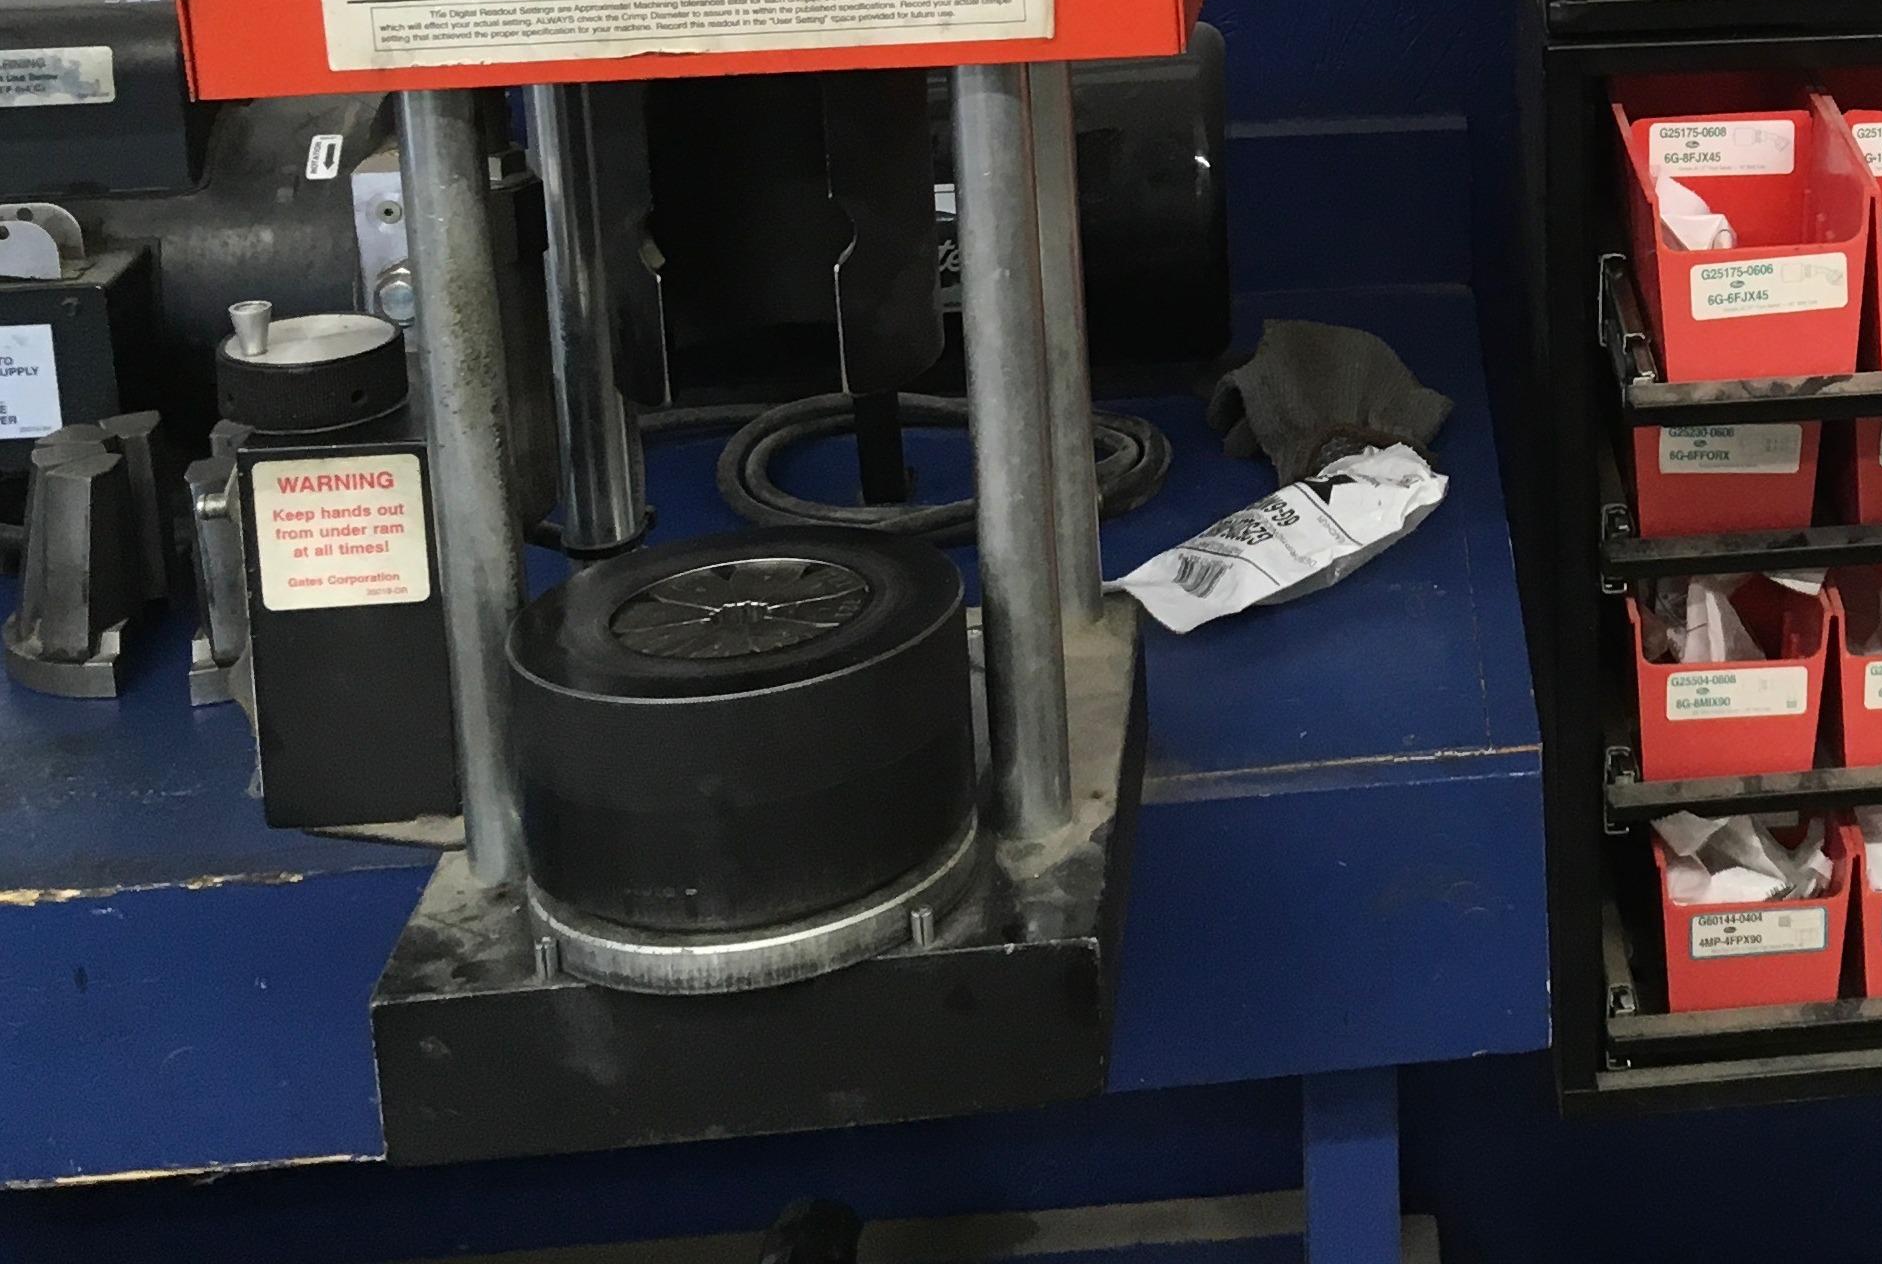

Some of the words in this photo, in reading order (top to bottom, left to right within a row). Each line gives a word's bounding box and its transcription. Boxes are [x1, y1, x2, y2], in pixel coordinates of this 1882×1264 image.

[1660, 125, 1727, 139] G25175-0608
[1664, 151, 1721, 164] 6G-8FJX45
[1701, 264, 1774, 280] G25175-0606
[1707, 289, 1769, 305] 6G-6FJX45
[278, 471, 395, 494] WARNING
[272, 509, 315, 523] Keep
[321, 505, 371, 519] hands
[377, 503, 404, 516] out
[275, 528, 314, 540] from
[319, 524, 367, 537] under
[373, 523, 404, 534] ram
[293, 546, 309, 558] at
[315, 544, 333, 556] all
[339, 540, 390, 555] times!
[288, 577, 323, 587] Gates
[328, 572, 400, 586] Corporation
[1671, 674, 1736, 688] G25504-0808
[1698, 914, 1763, 927] G60144-0404
[1699, 934, 1761, 948] 4MP-4FPX90
